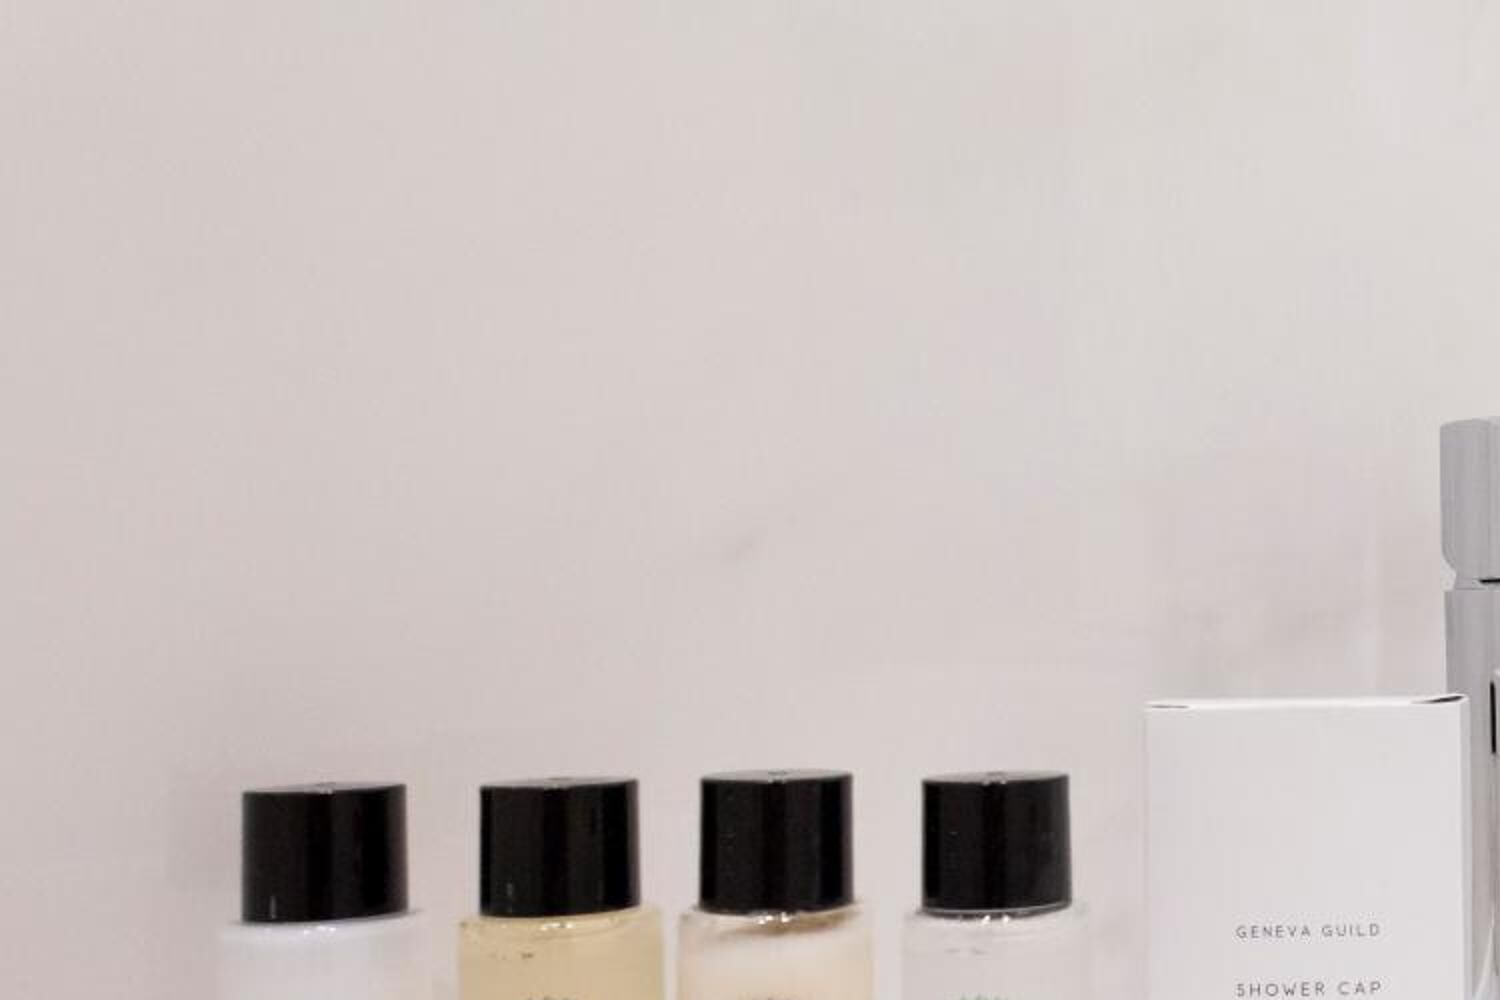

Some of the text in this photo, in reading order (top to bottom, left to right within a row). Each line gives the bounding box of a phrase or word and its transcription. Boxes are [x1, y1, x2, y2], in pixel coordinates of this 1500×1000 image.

[1235, 923, 1381, 939] GENEVA GUILD
[1236, 981, 1382, 998] SHOWER CAP
